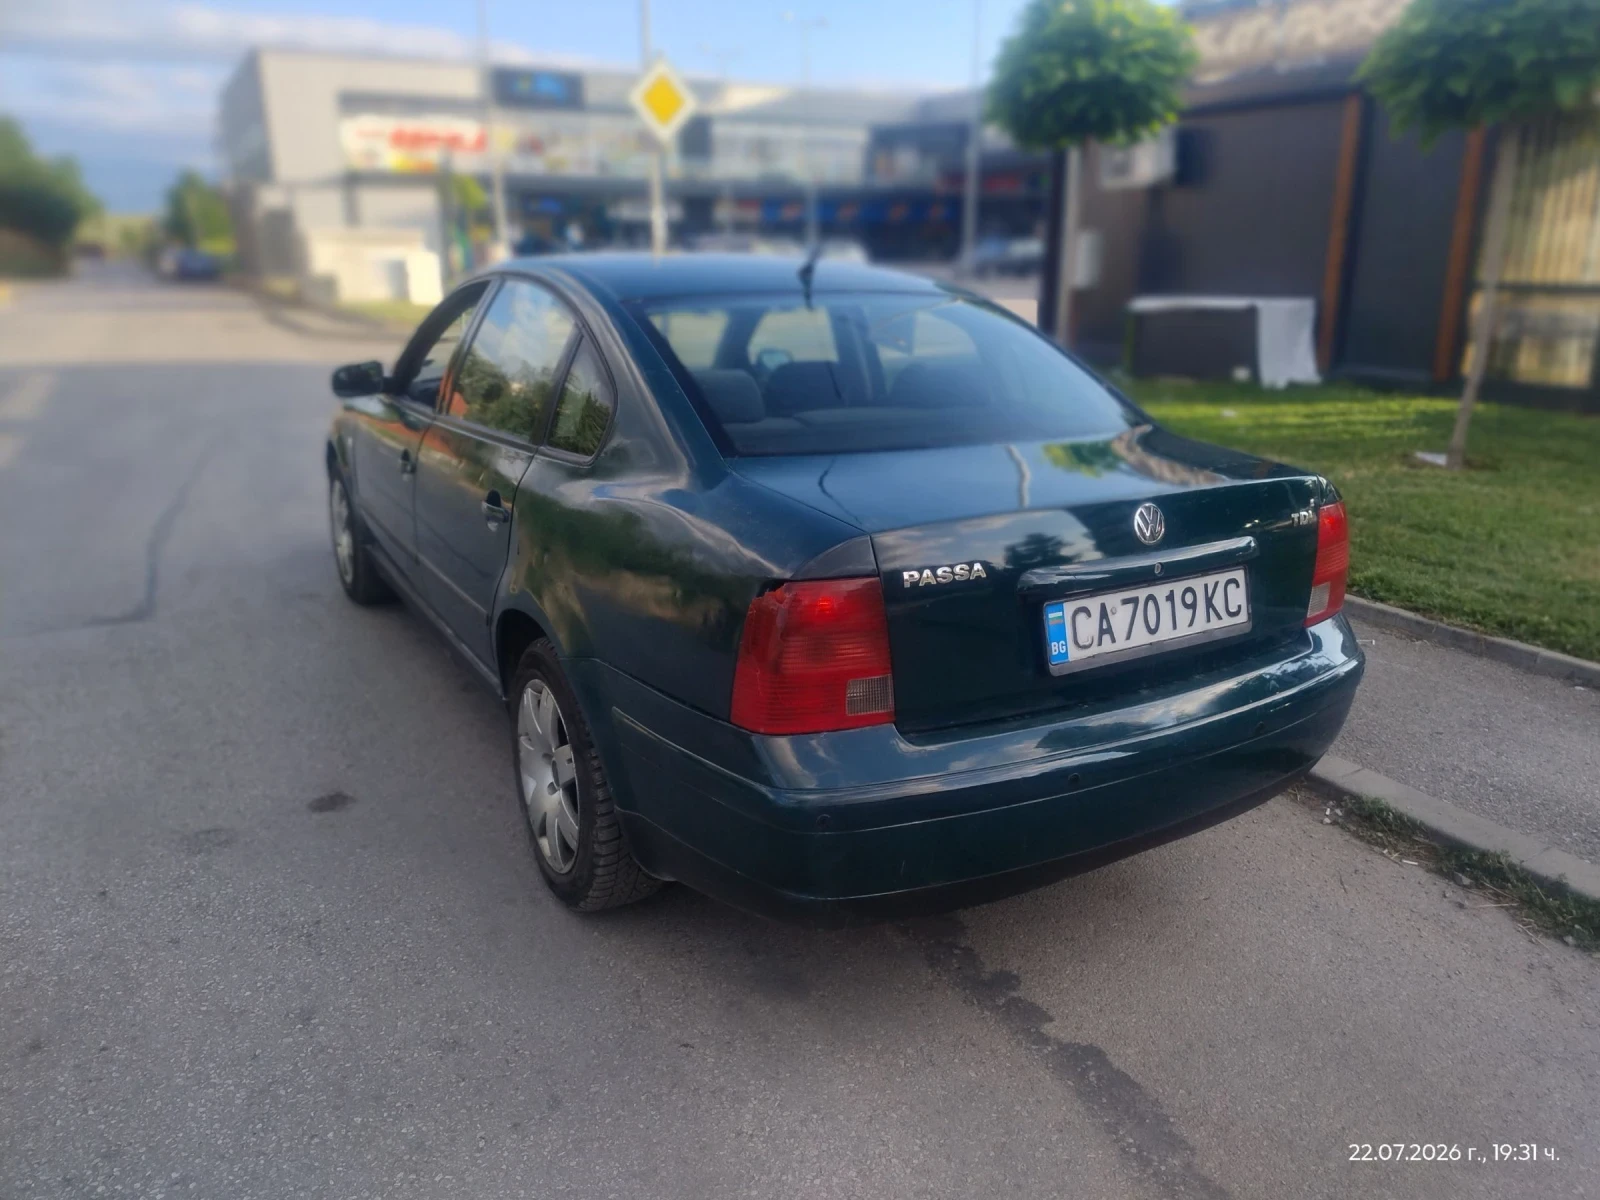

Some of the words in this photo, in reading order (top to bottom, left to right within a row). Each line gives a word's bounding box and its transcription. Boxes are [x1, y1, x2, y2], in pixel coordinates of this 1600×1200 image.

[903, 563, 987, 588] PASSA
[1071, 577, 1242, 650] CA7019KC
[1051, 641, 1067, 656] BG
